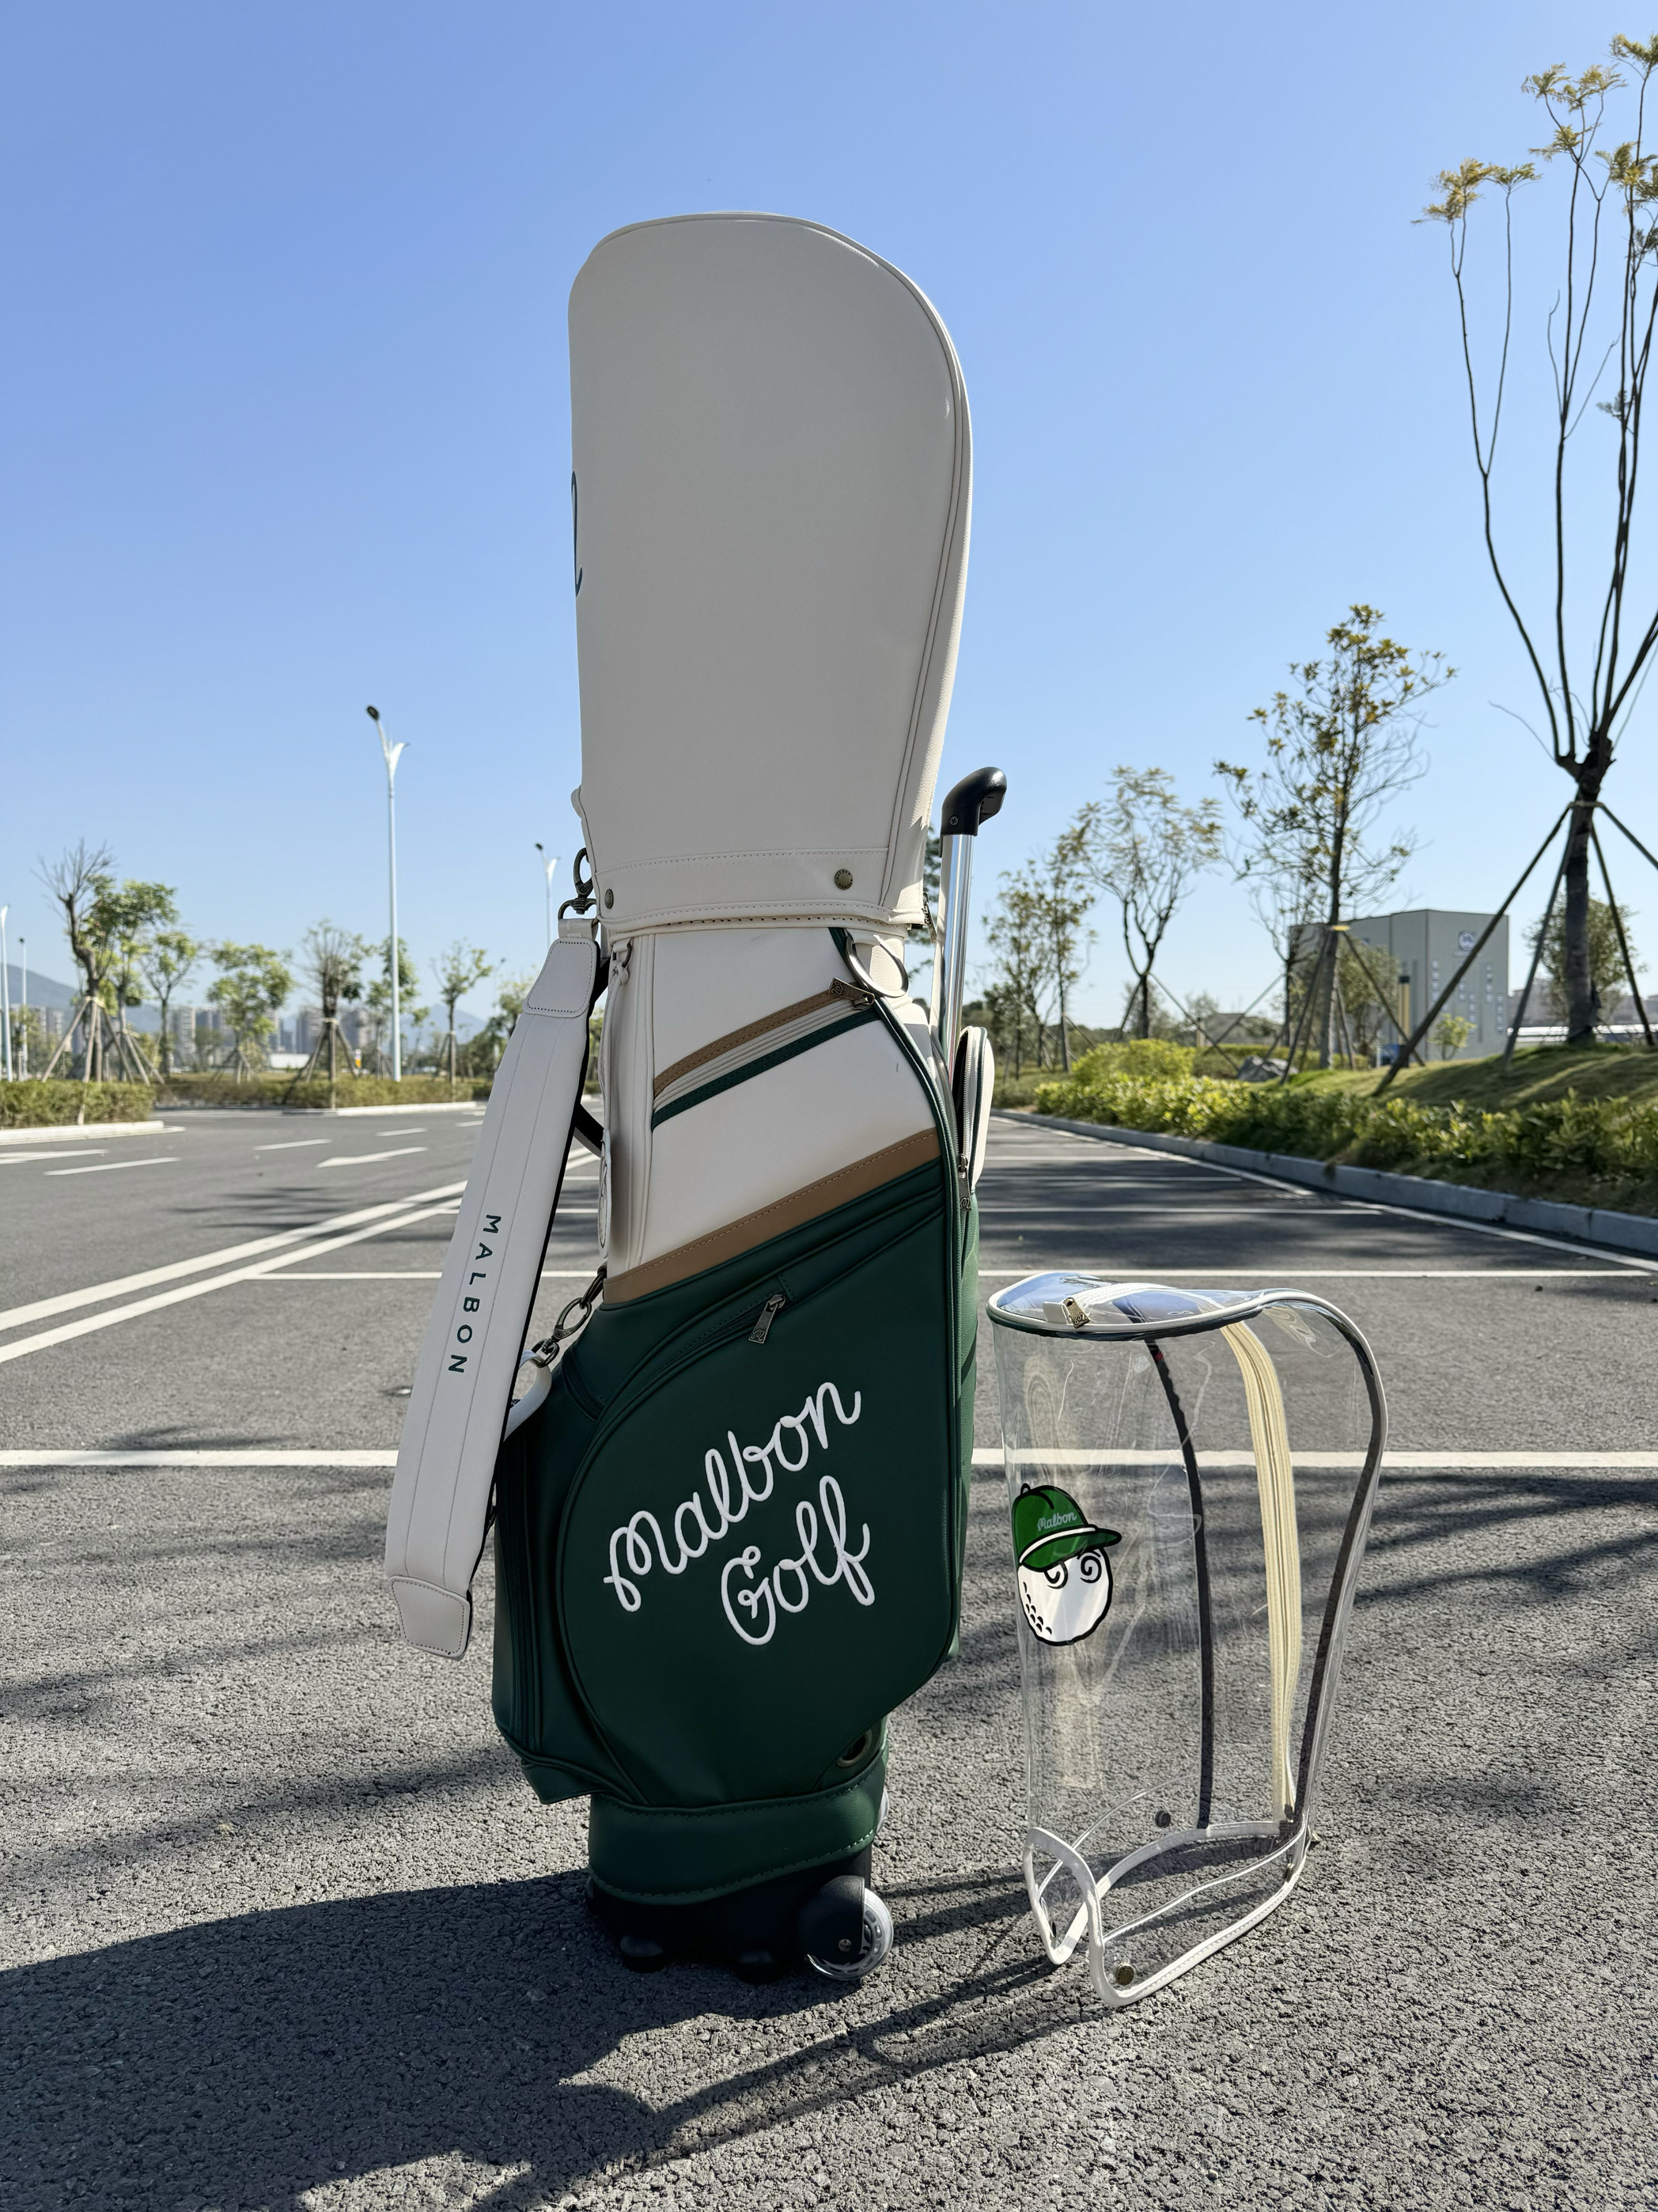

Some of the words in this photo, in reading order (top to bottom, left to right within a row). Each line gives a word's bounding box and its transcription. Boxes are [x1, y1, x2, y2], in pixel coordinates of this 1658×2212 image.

[448, 1214, 502, 1373] MALBON
[603, 1381, 861, 1612] Malbon
[721, 1475, 876, 1646] Golf
[1037, 1512, 1077, 1532] Malbon
